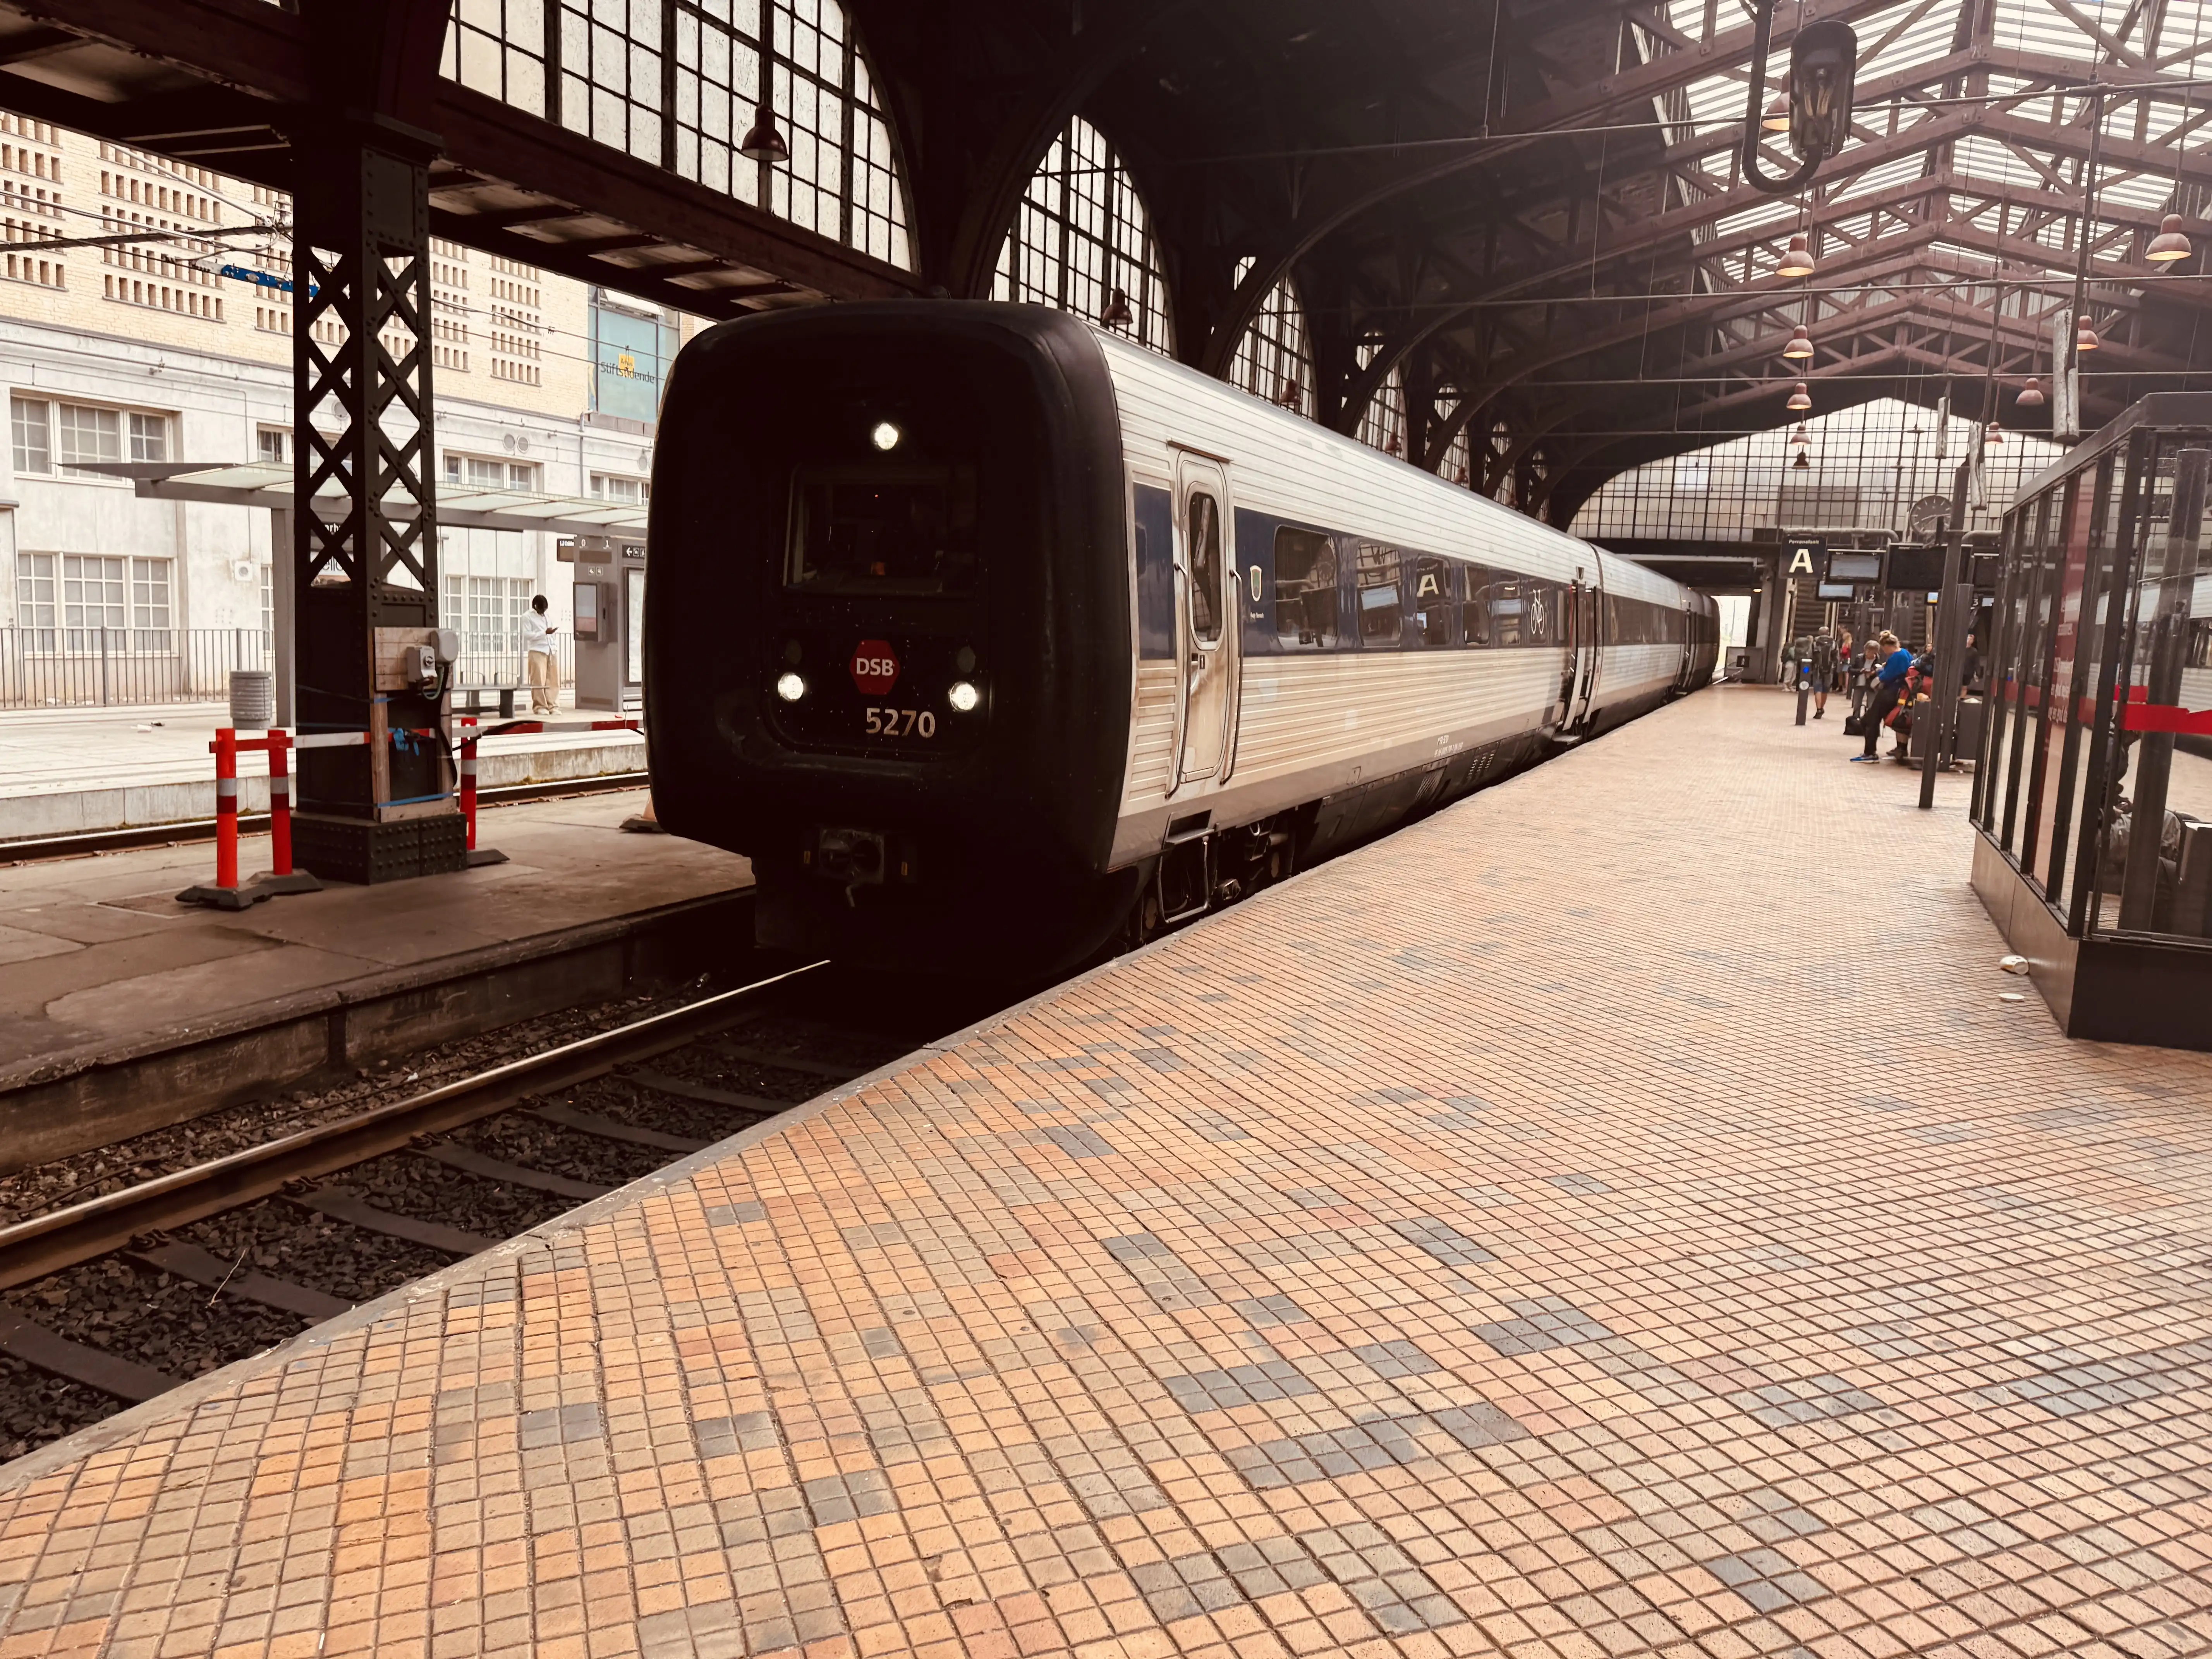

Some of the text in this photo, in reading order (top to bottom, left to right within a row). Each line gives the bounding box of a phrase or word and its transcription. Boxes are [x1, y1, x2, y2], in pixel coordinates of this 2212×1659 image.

[601, 361, 654, 384] Stiftstidende
[1788, 548, 1813, 573] A
[856, 658, 893, 676] DSB
[866, 708, 935, 738] 5270
